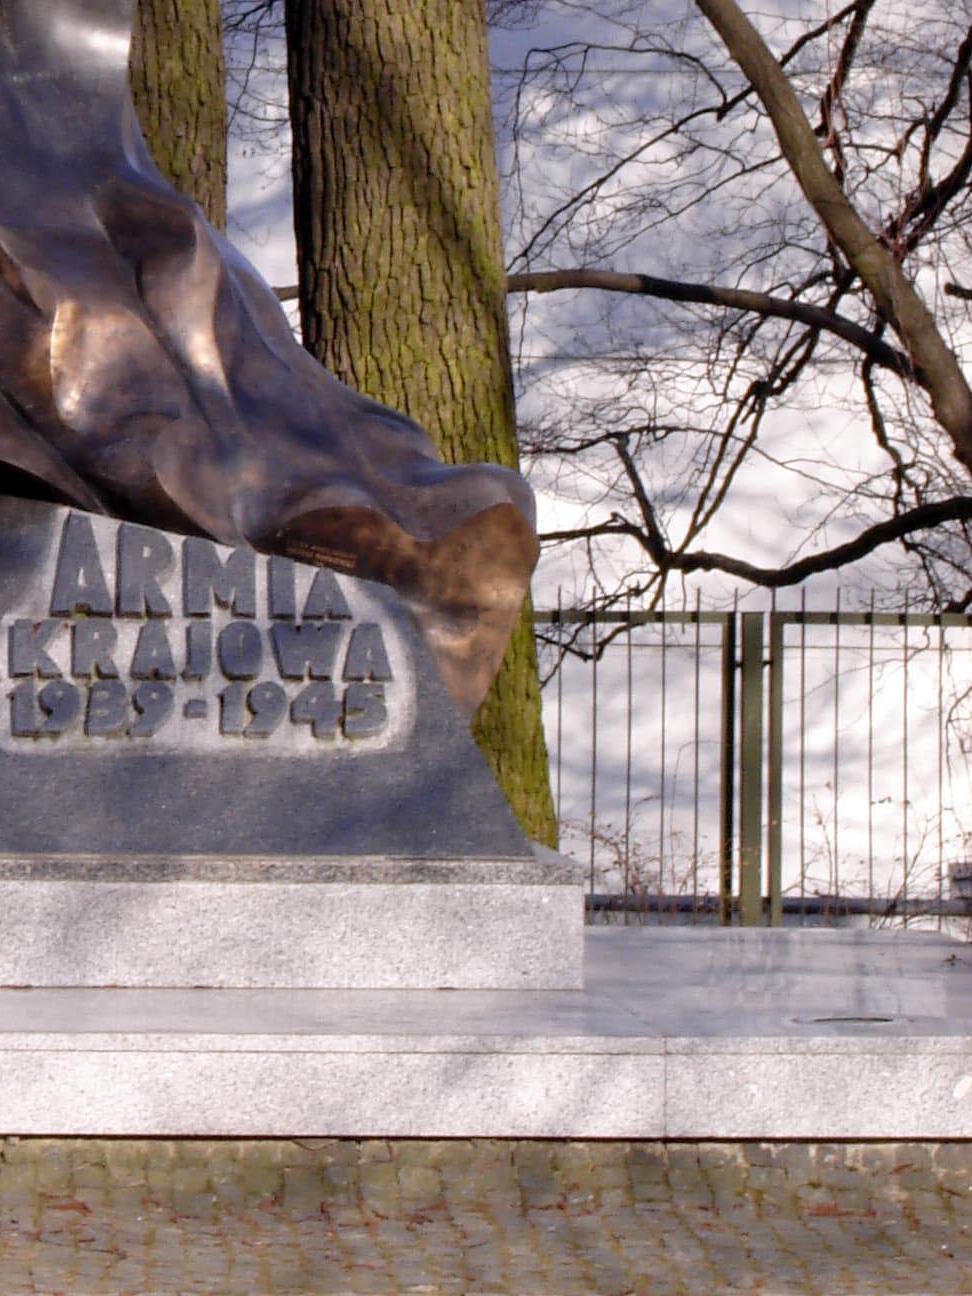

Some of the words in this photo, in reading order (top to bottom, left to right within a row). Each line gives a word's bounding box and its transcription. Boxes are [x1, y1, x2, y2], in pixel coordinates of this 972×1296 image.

[49, 512, 353, 618] ARMIA
[7, 618, 393, 680] KRAJOWA
[7, 680, 388, 740] 1939-1945
